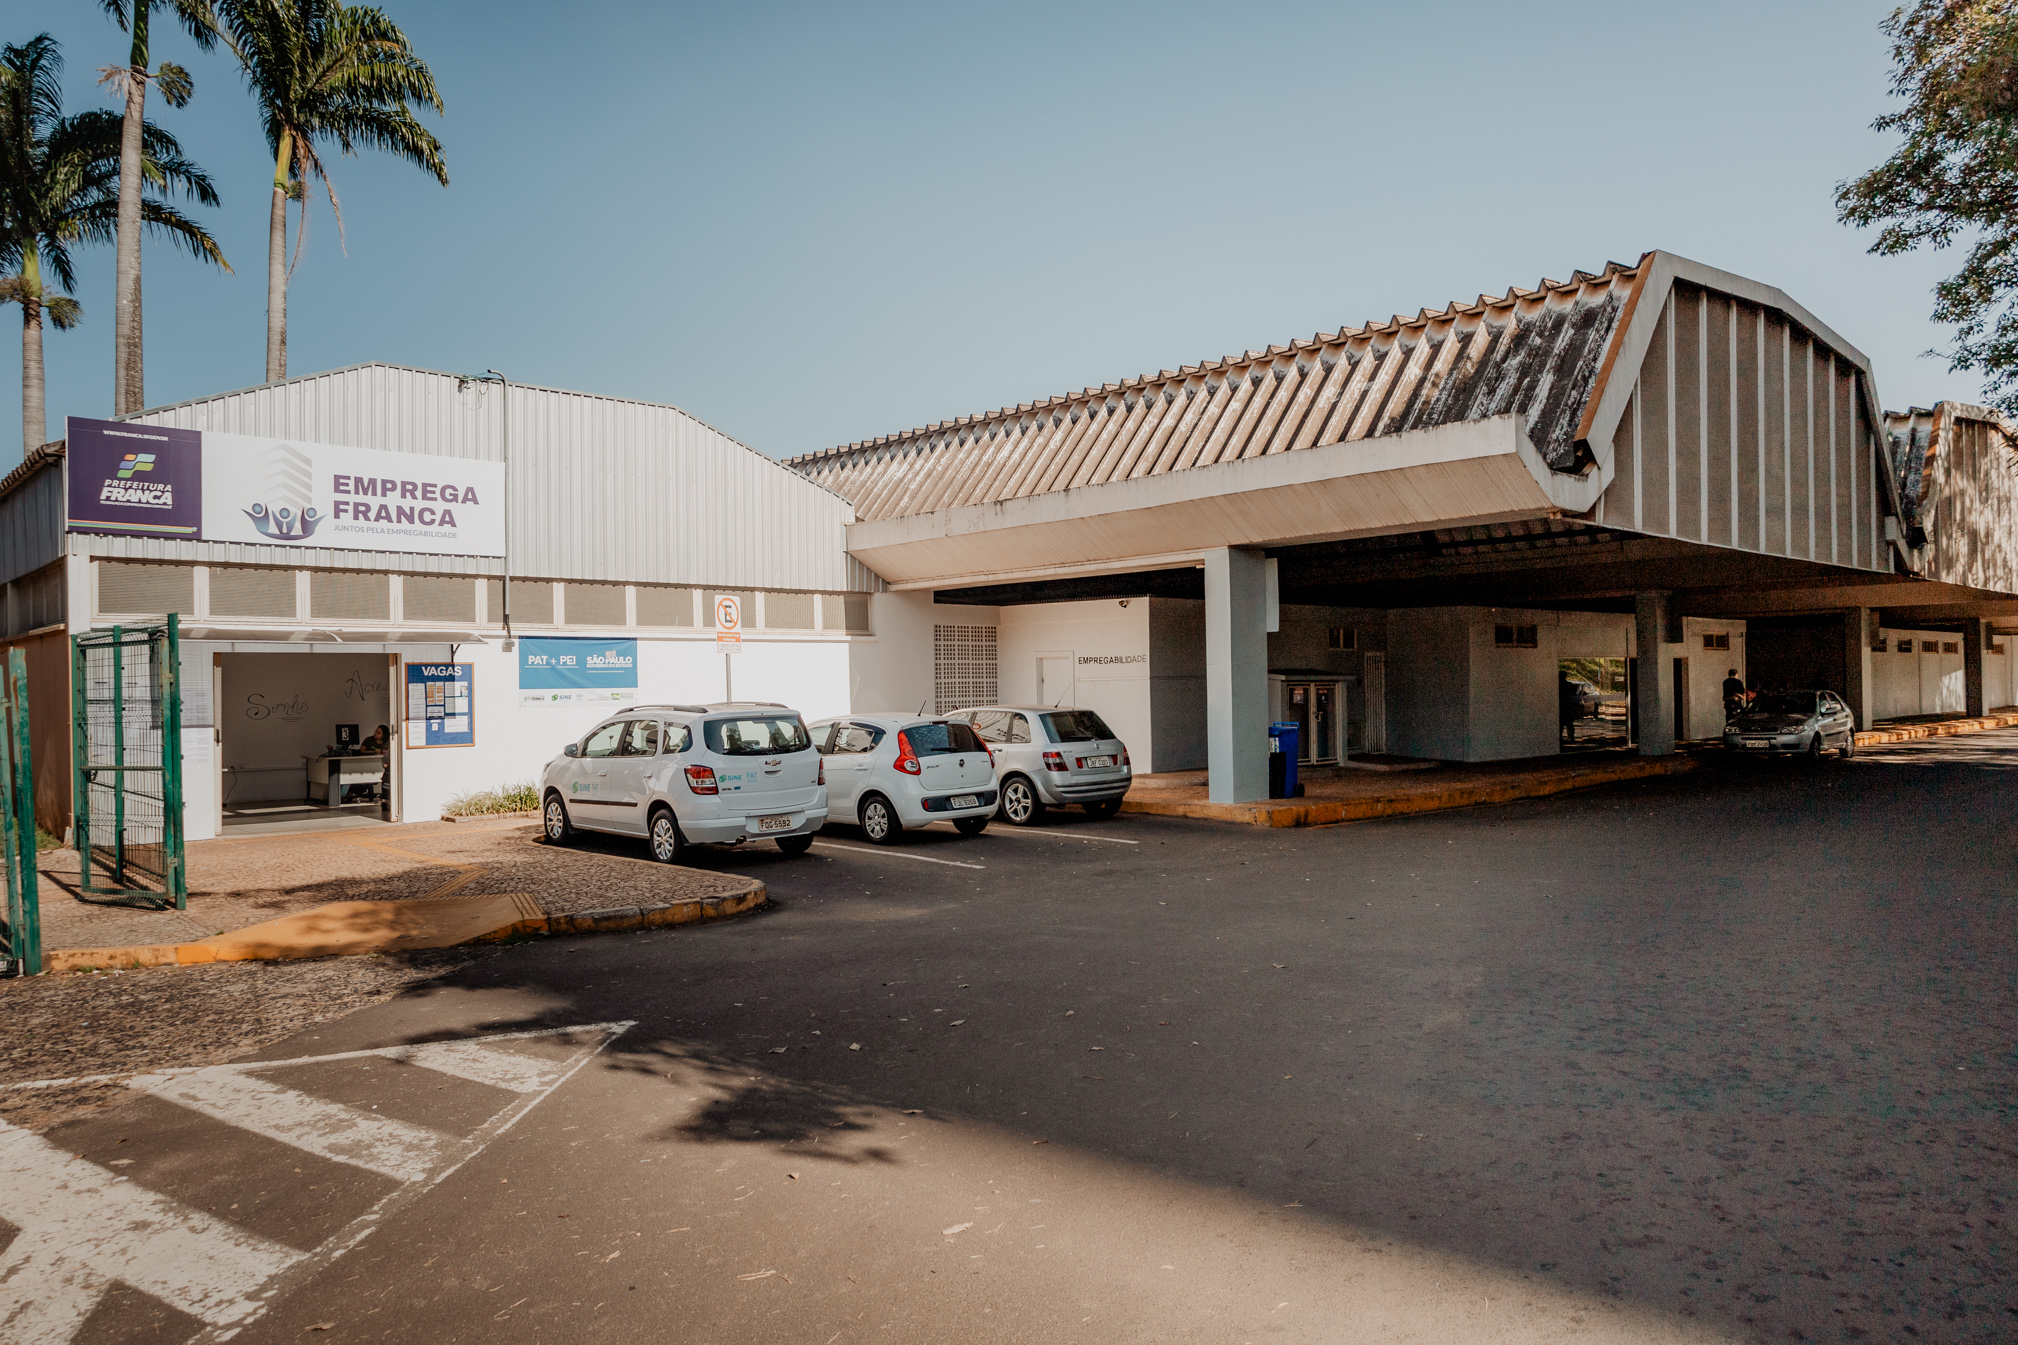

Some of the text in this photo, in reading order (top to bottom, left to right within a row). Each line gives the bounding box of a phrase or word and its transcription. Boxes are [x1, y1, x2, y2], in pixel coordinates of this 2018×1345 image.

[104, 479, 172, 492] PREFEITURA
[333, 474, 480, 505] EMPREGA
[100, 486, 173, 505] FRANCA
[333, 500, 457, 528] FRANCA
[334, 524, 458, 539] JUNTOS PELA EMPREGABILIDADE
[528, 655, 549, 665] PAT
[560, 655, 577, 665] PEI
[586, 654, 633, 664] SÃO PAULO
[1078, 654, 1147, 665] EMPREGABILIDADE
[421, 666, 463, 676] VAGAS
[246, 693, 310, 720] Sonhe
[342, 729, 349, 740] 3
[746, 771, 758, 779] FAT
[579, 783, 591, 792] SINE
